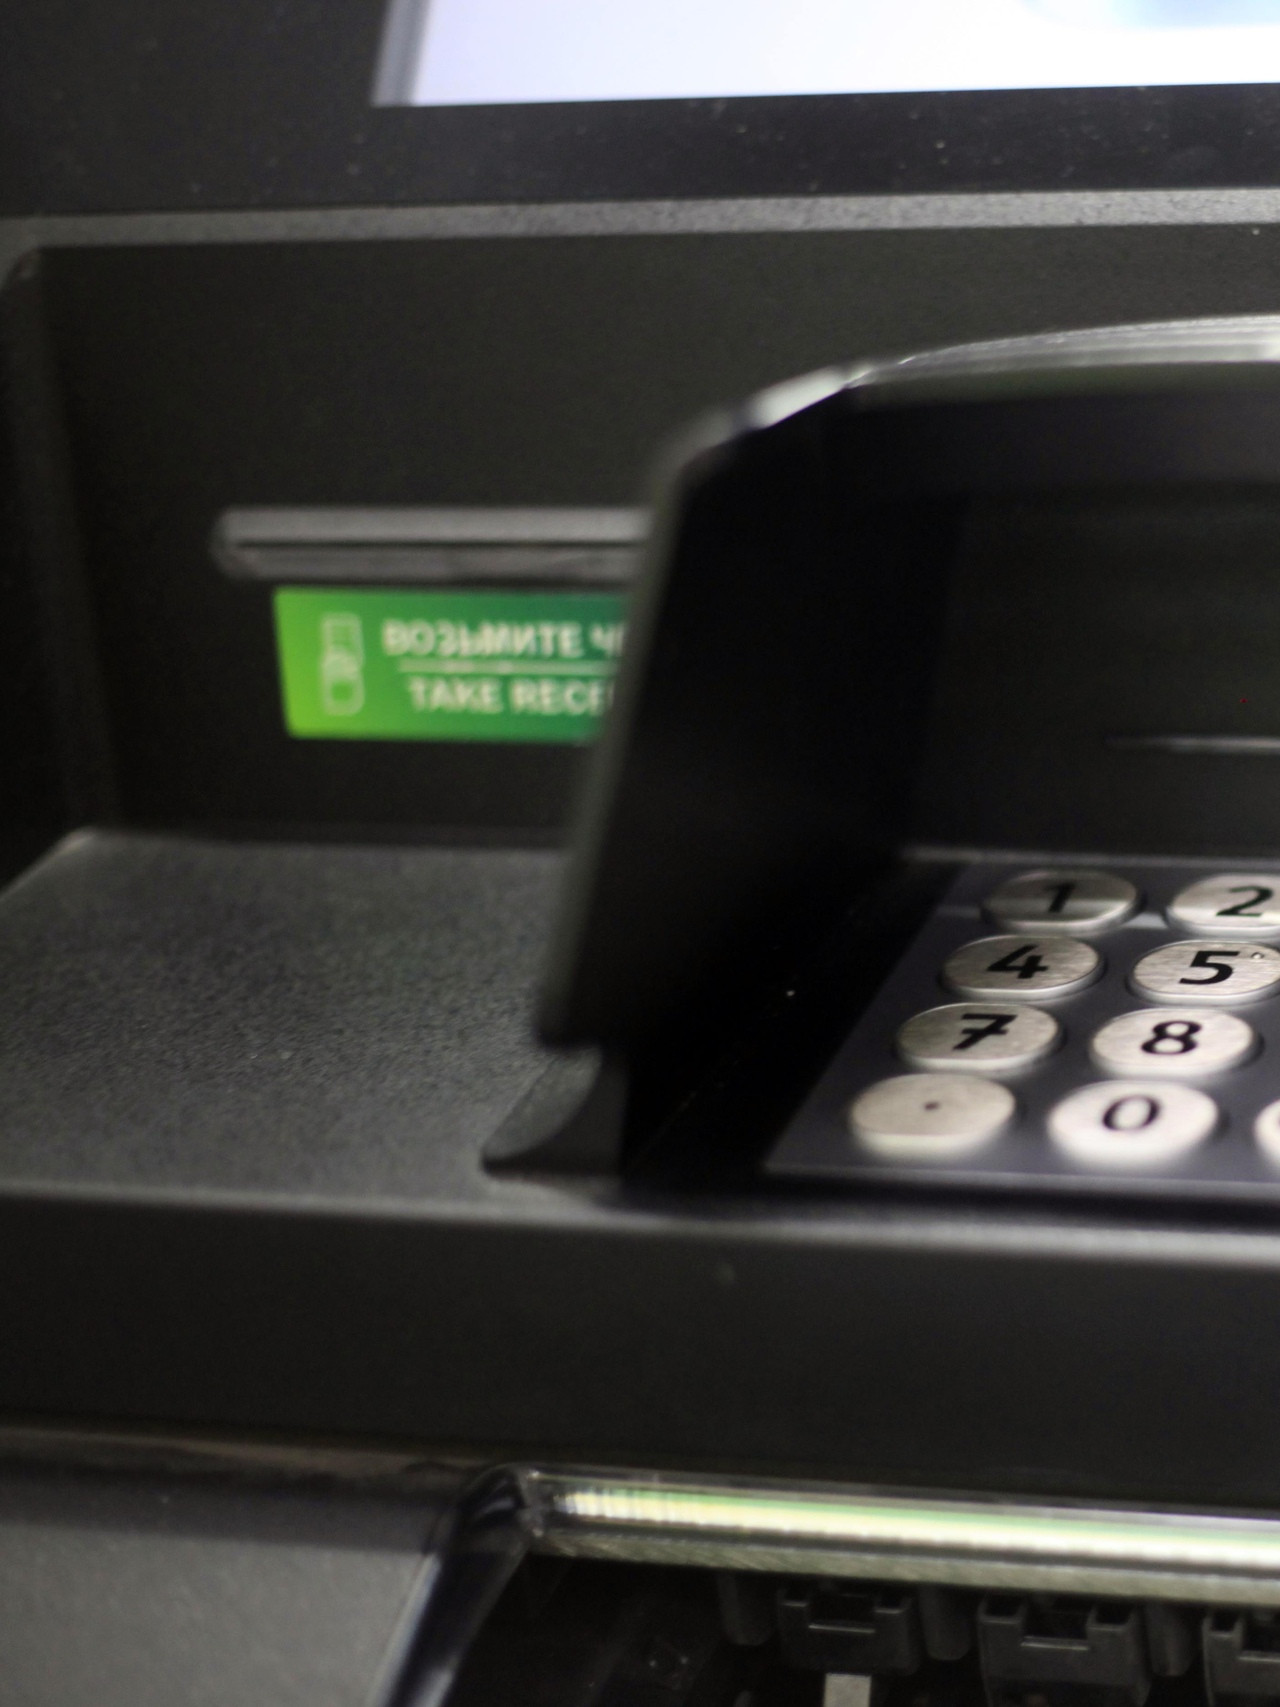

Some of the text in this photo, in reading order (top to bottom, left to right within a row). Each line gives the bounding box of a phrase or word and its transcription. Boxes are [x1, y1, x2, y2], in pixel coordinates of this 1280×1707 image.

[382, 619, 584, 657] ВОЗЬМИТЕ
[408, 676, 504, 713] TAKE
[1040, 881, 1073, 912] 1
[1215, 885, 1274, 917] 2
[986, 944, 1047, 979] 4
[1177, 950, 1240, 985] 5
[952, 1013, 1017, 1051] 7
[1140, 1020, 1202, 1056] 8
[1101, 1095, 1162, 1133] 0
